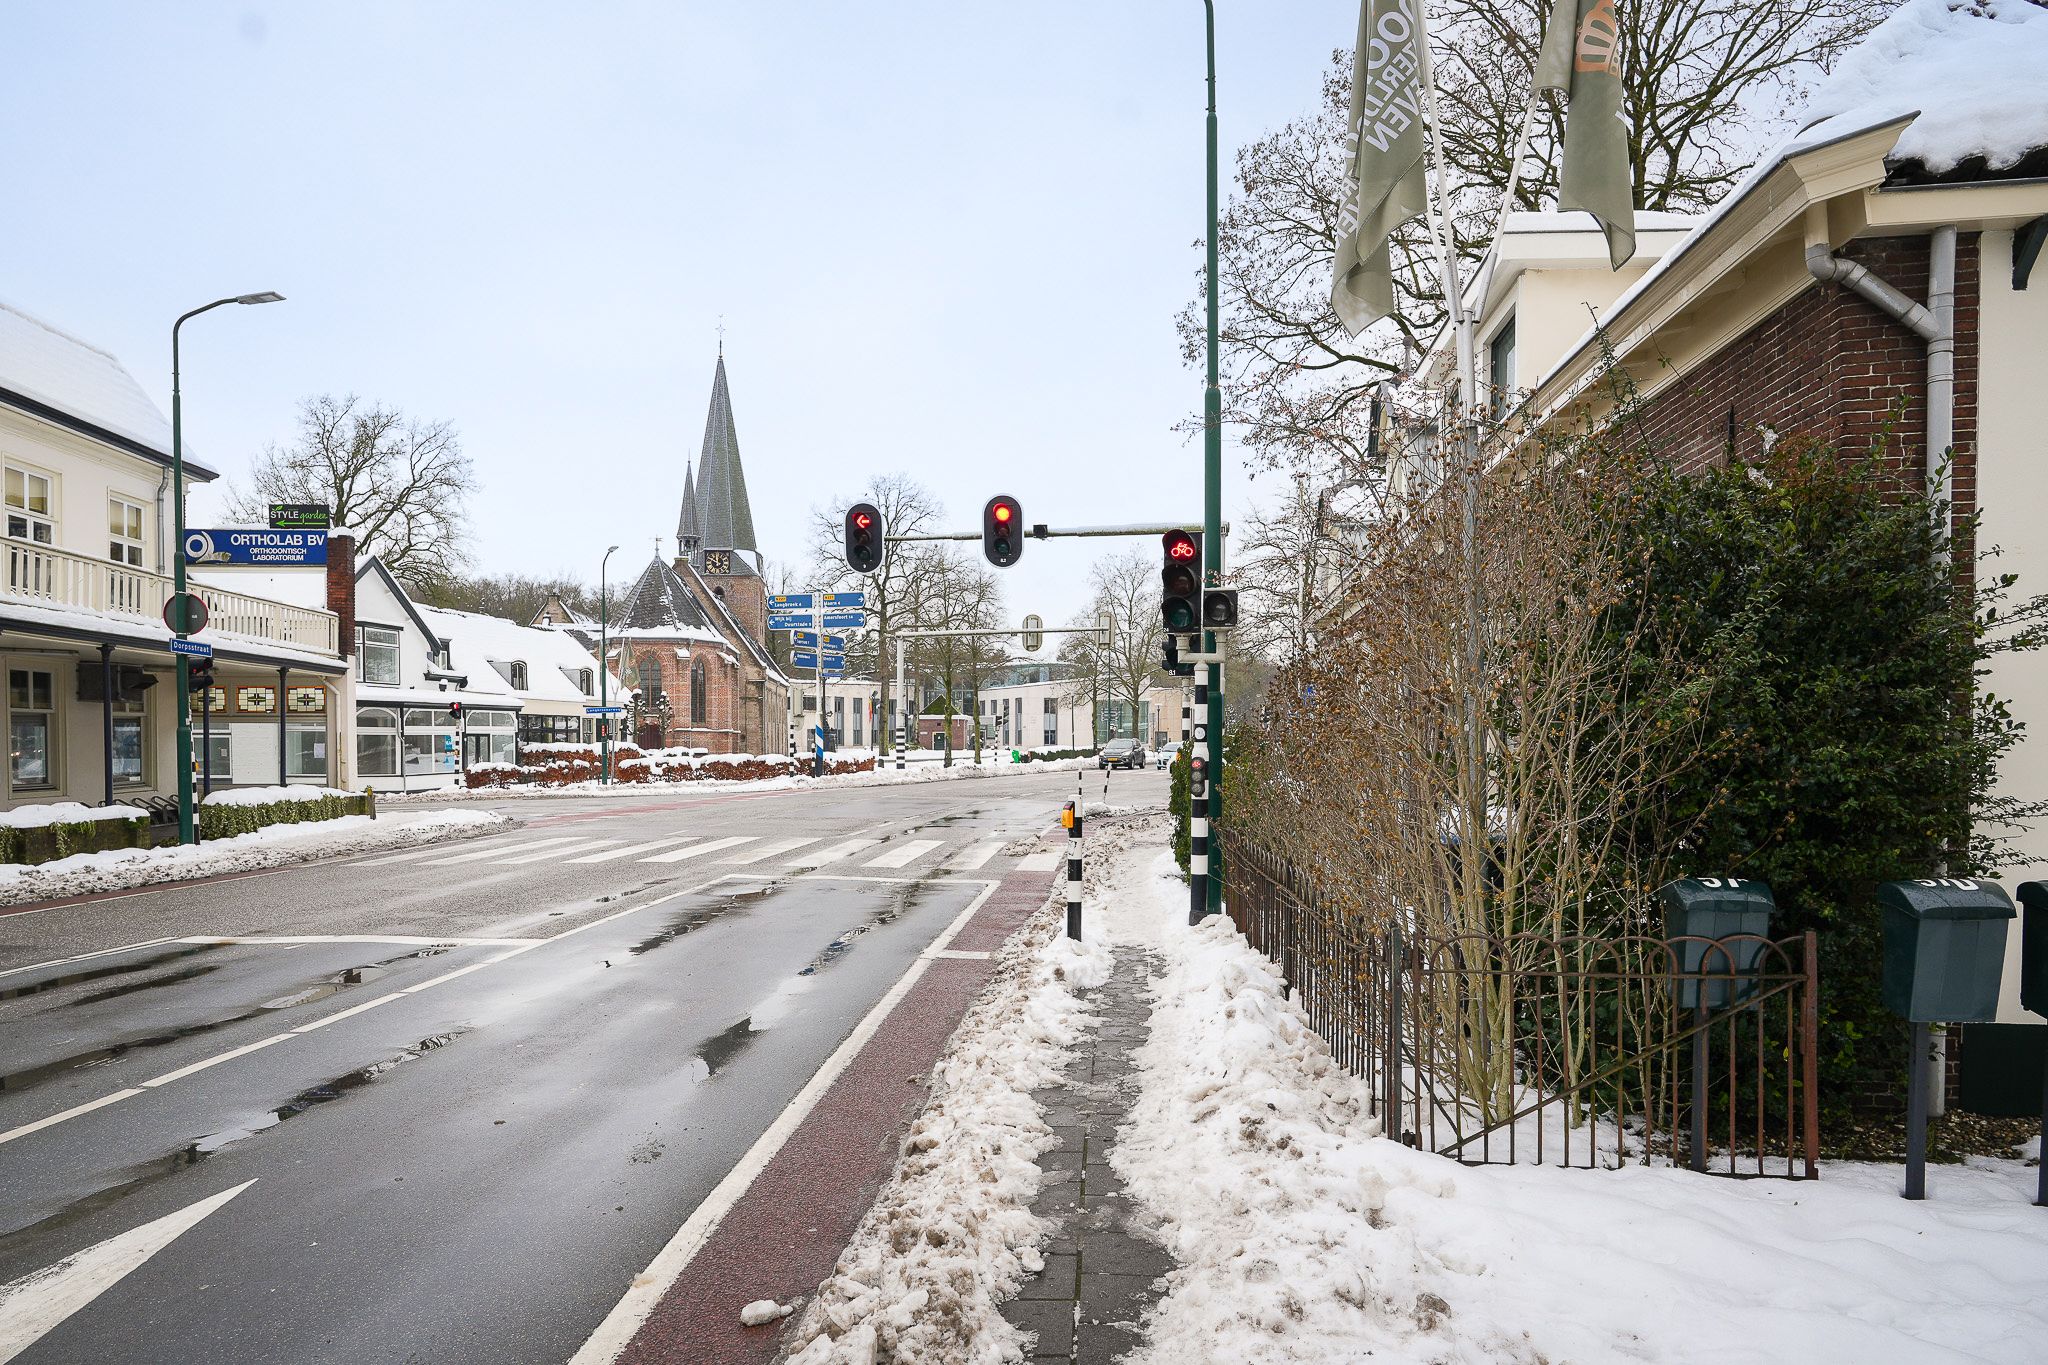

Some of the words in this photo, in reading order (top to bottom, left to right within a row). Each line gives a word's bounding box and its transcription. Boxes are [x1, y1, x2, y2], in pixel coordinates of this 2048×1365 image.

[270, 511, 299, 519] STYLE
[300, 509, 328, 524] garden
[230, 533, 303, 546] ORTHOLAB
[307, 534, 325, 546] BV
[173, 641, 210, 653] Dorpsstraat
